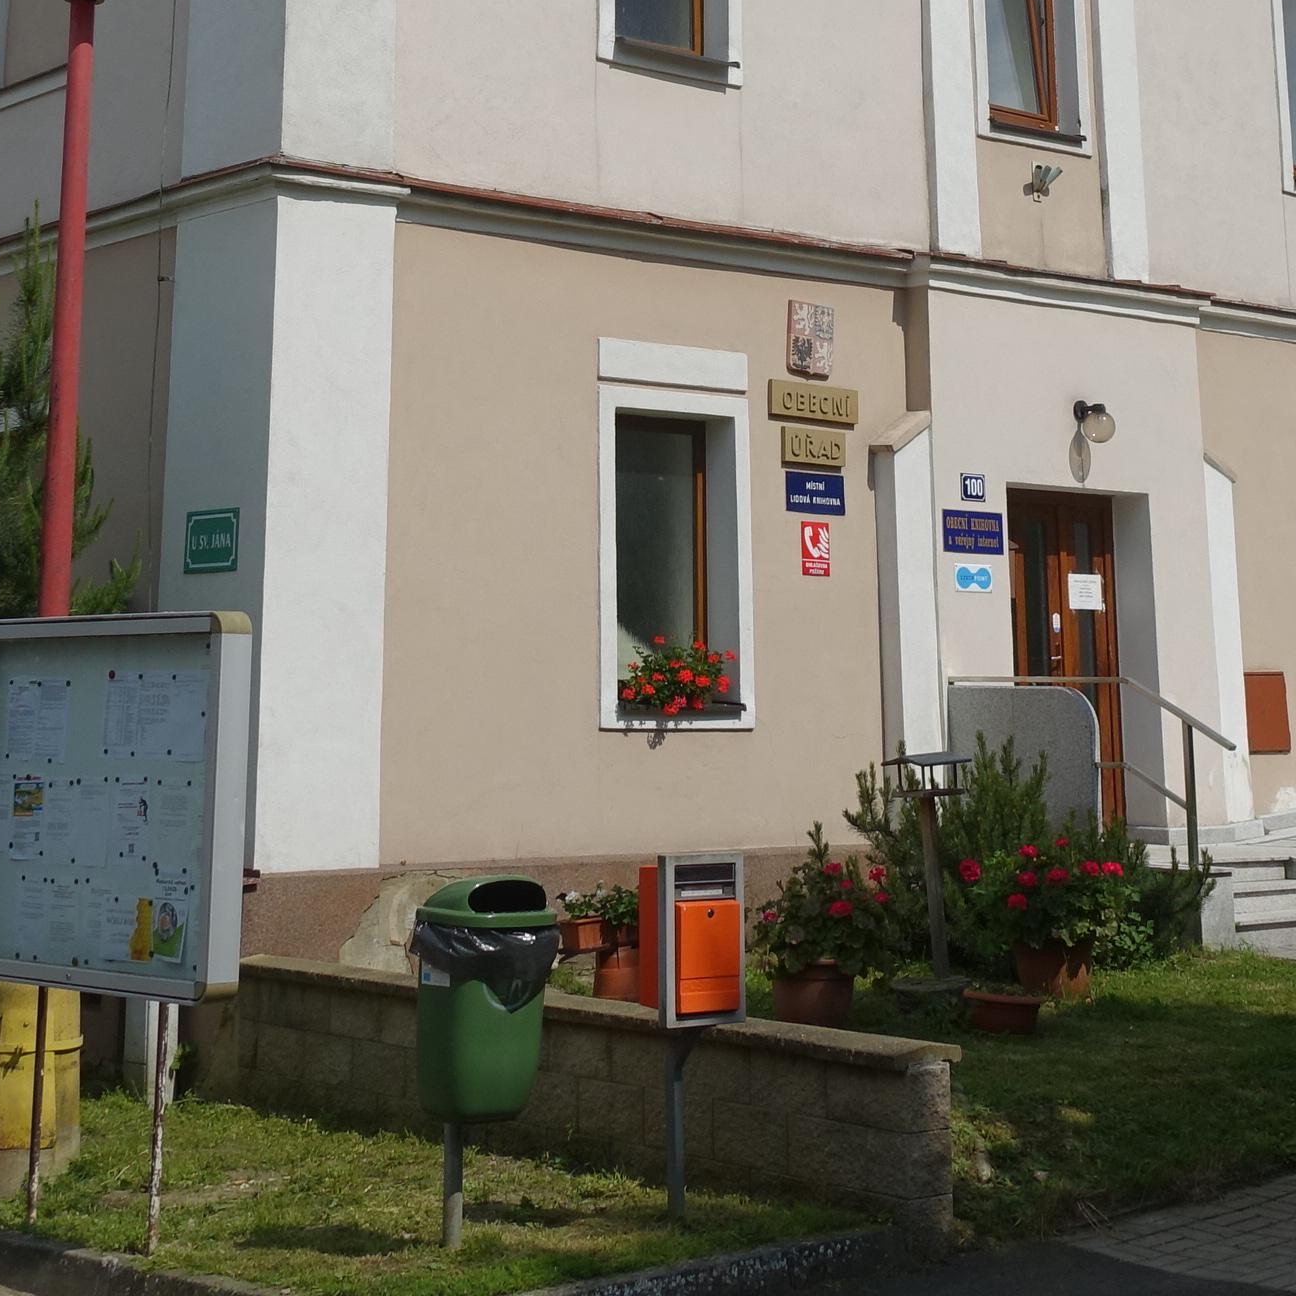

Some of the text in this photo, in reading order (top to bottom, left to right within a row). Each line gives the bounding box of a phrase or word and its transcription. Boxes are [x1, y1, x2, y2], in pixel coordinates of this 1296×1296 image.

[782, 390, 851, 418] OBECNÍ
[790, 433, 841, 461] ÚŘAD
[805, 480, 825, 491] MÍSTNÍ
[965, 478, 983, 497] 100
[790, 494, 841, 506] LIDOVÁ KNIHOVNA
[191, 535, 197, 550] U
